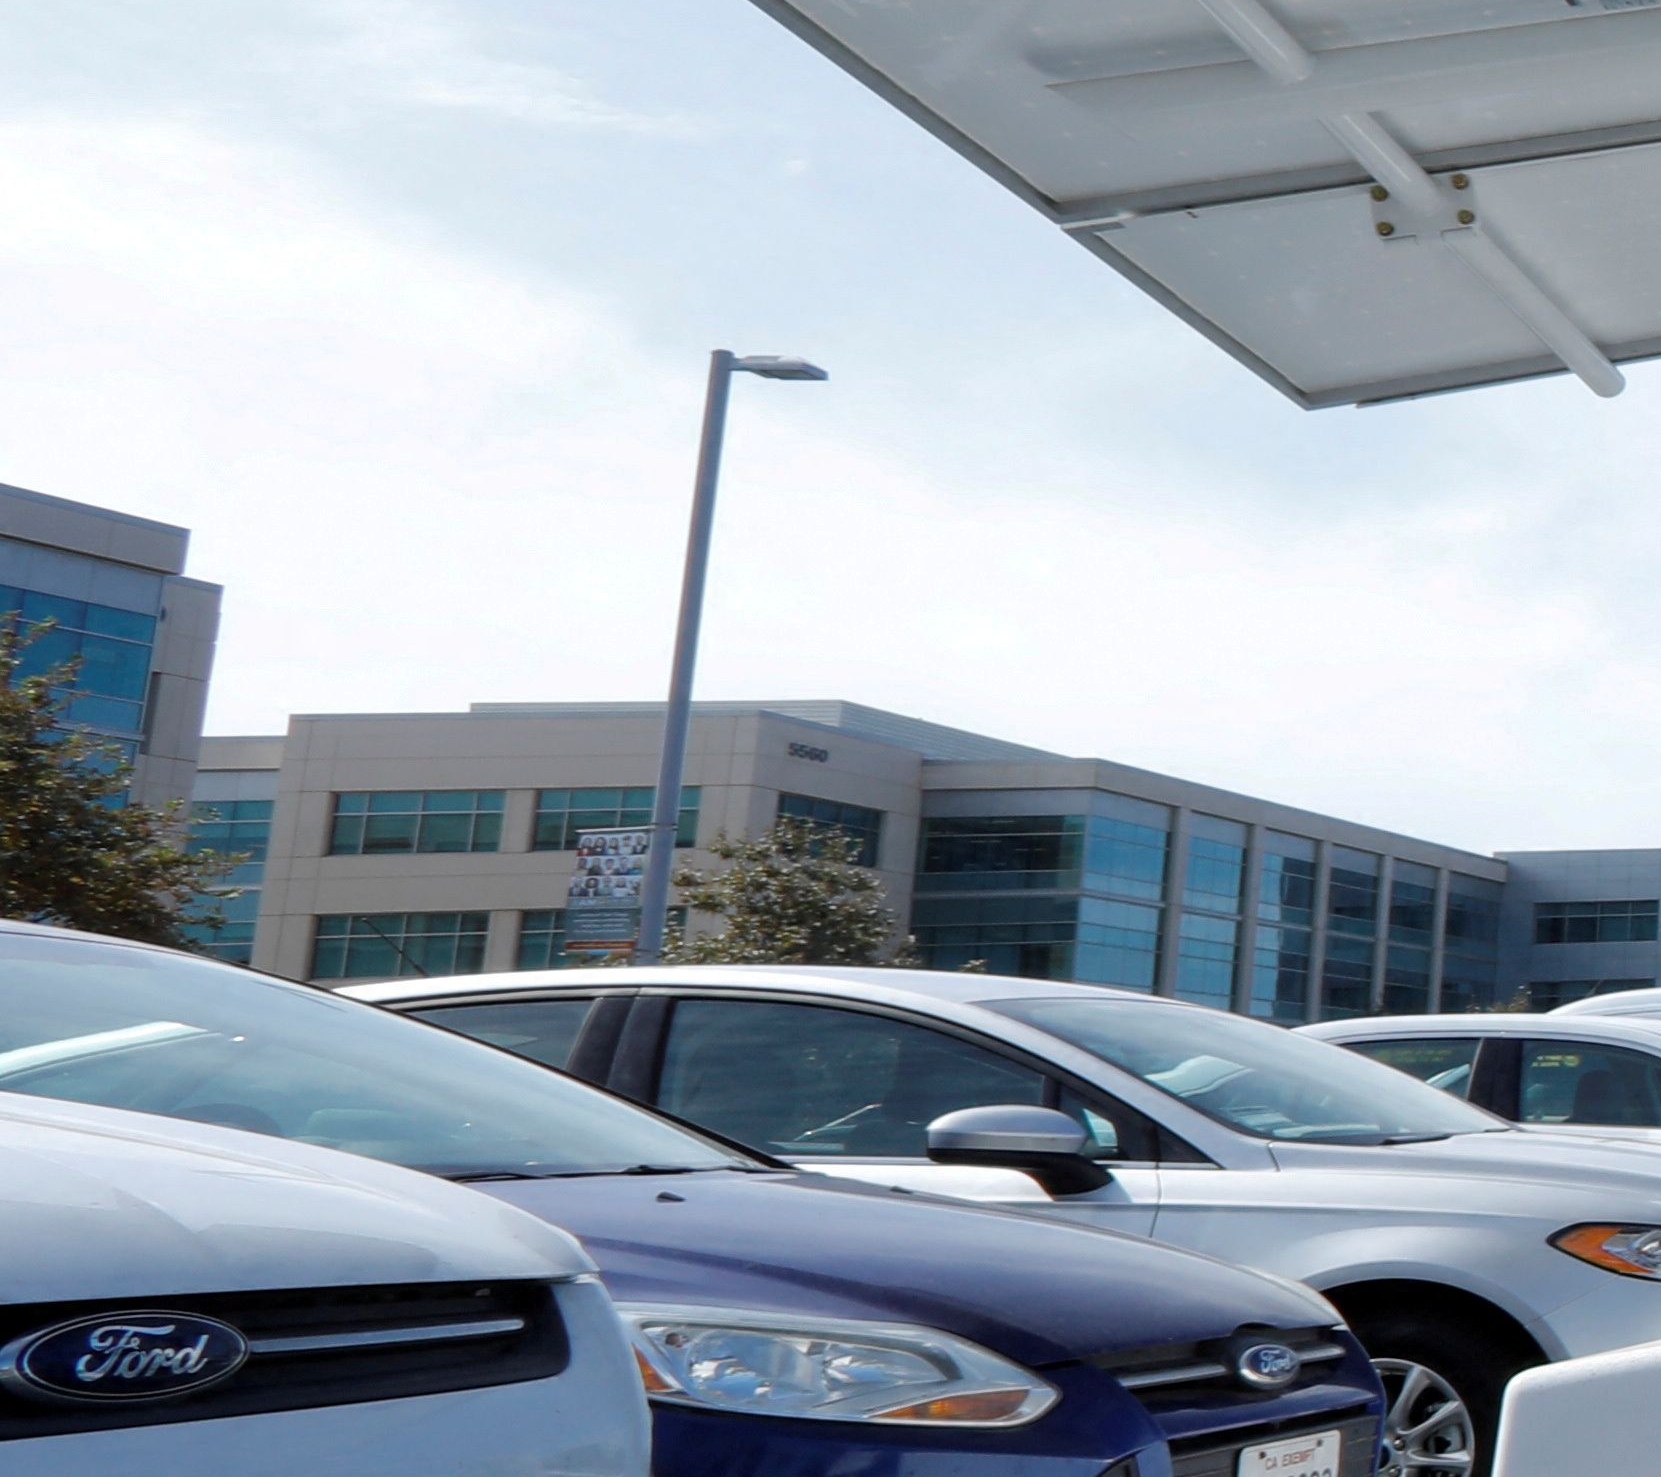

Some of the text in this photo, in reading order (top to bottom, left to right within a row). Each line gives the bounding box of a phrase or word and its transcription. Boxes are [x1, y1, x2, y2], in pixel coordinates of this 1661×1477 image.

[75, 1324, 210, 1382] Ford
[1260, 1349, 1291, 1374] Ford
[1264, 1458, 1277, 1470] CA
